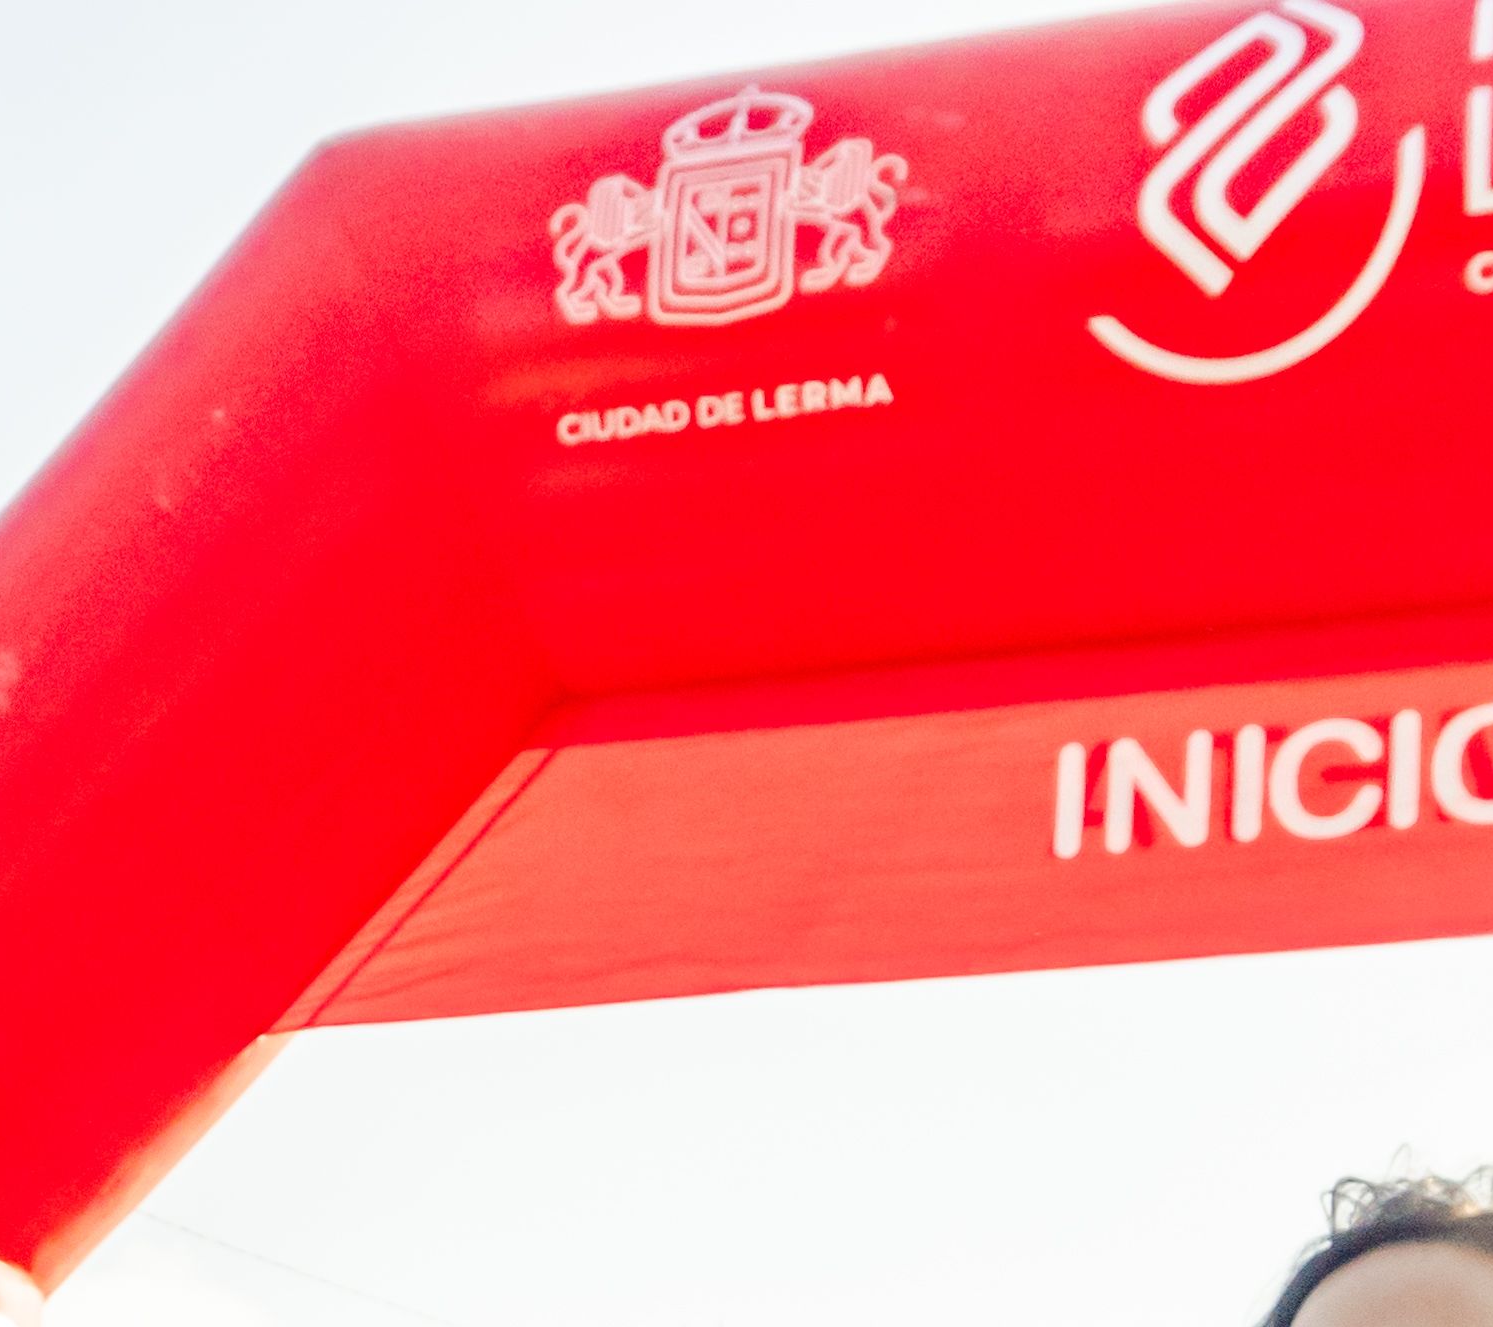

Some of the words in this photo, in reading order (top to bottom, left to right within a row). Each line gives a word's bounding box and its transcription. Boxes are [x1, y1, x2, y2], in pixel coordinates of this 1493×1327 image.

[556, 399, 691, 446] CIUDAD
[695, 391, 746, 429] DE
[750, 373, 894, 423] LERMA
